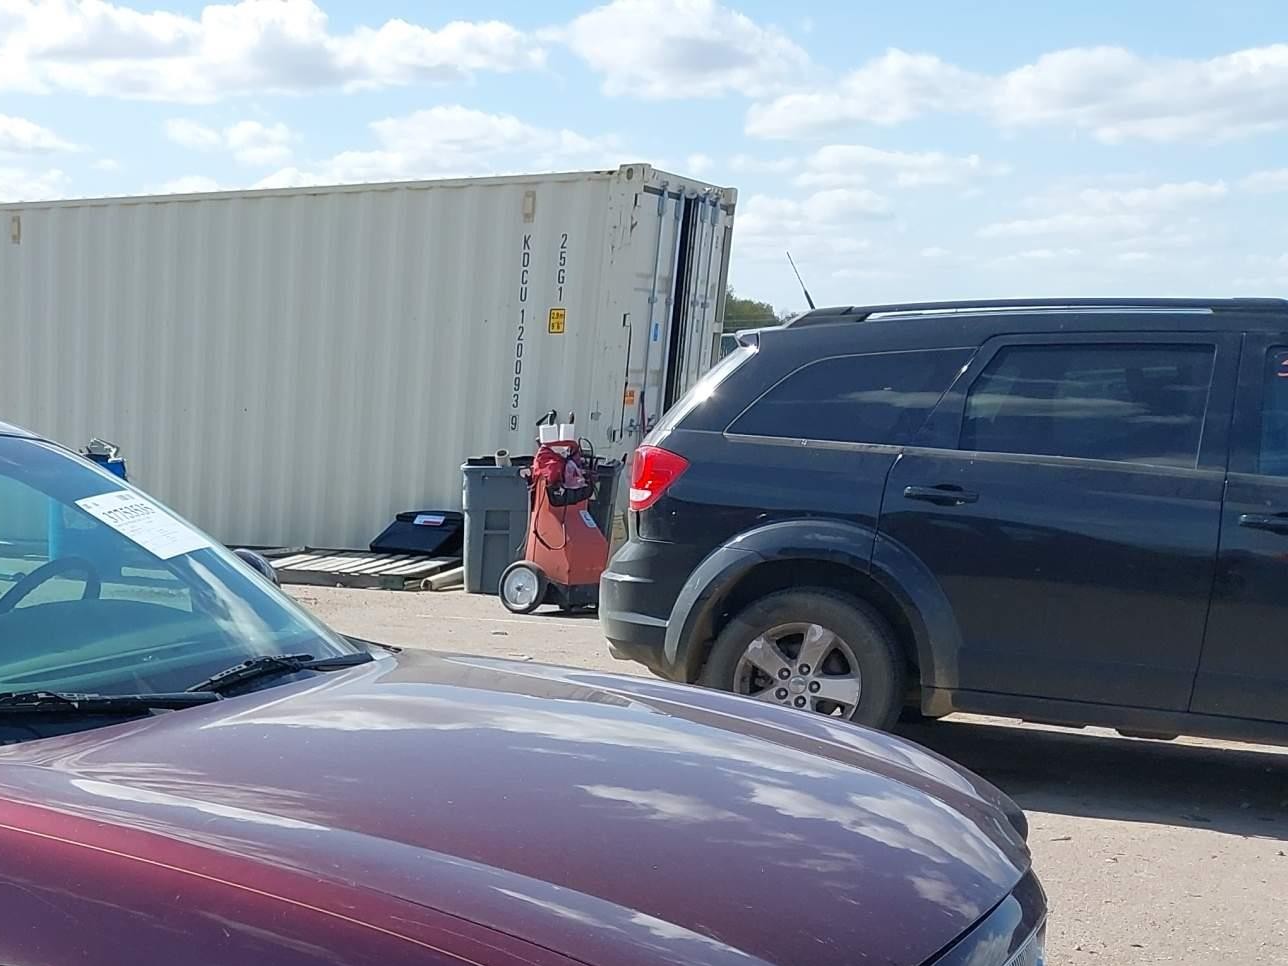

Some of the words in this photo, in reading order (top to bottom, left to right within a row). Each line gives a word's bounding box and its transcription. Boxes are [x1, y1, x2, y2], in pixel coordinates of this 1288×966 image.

[519, 234, 531, 302] KDCU
[557, 233, 568, 301] 25G1
[512, 309, 524, 408] 120093
[510, 415, 518, 431] 9
